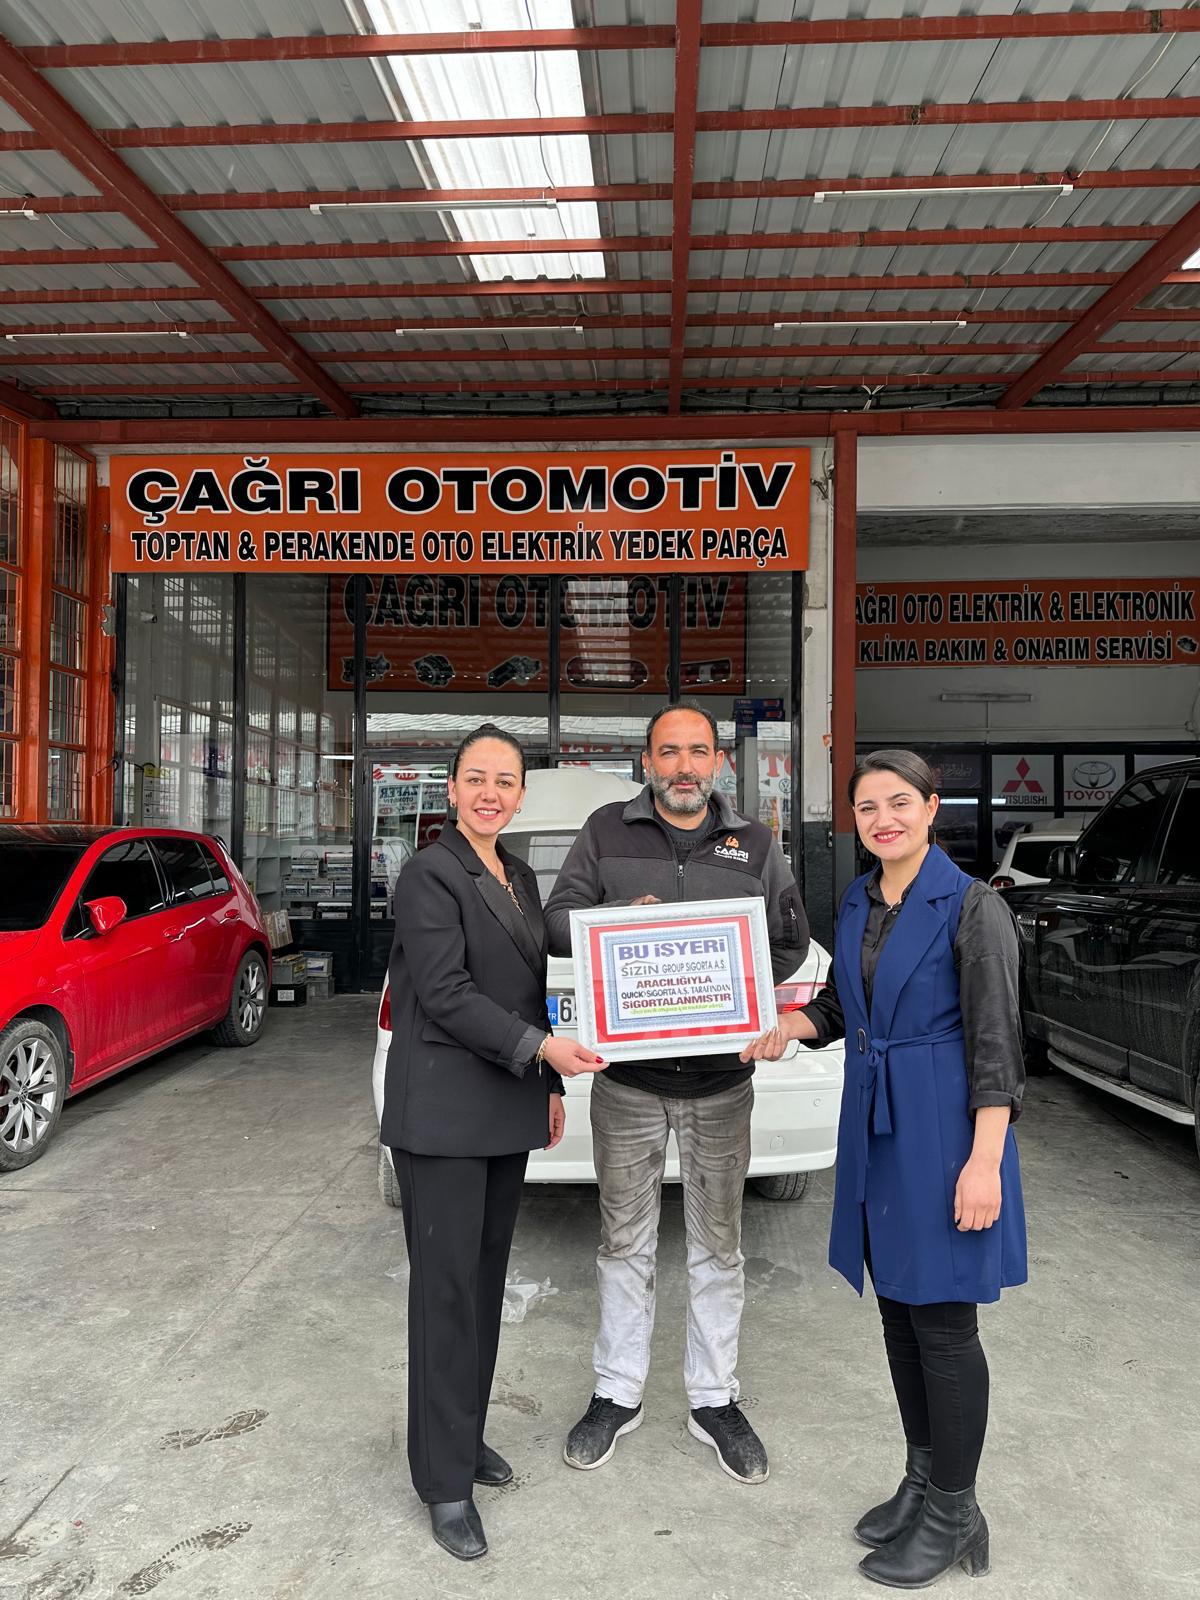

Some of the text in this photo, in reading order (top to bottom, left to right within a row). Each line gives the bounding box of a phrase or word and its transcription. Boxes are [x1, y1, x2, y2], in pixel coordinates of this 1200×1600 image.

[127, 452, 795, 526] ÇAĞRI OTOMOTİV
[131, 522, 788, 567] TOPTAN & PERAKENDE OTO ELEKTRİK YEDEK PARÇA
[856, 582, 1195, 624] AĞRI OTO ELEKTRİK & ELEKTRONİK
[859, 630, 1172, 663] KLİMA BAKIM & ONARIM SERVİSİ
[1065, 790, 1115, 801] TOYOT
[619, 944, 649, 960] BU
[662, 963, 685, 974] GROUP
[560, 997, 577, 1023] 6
